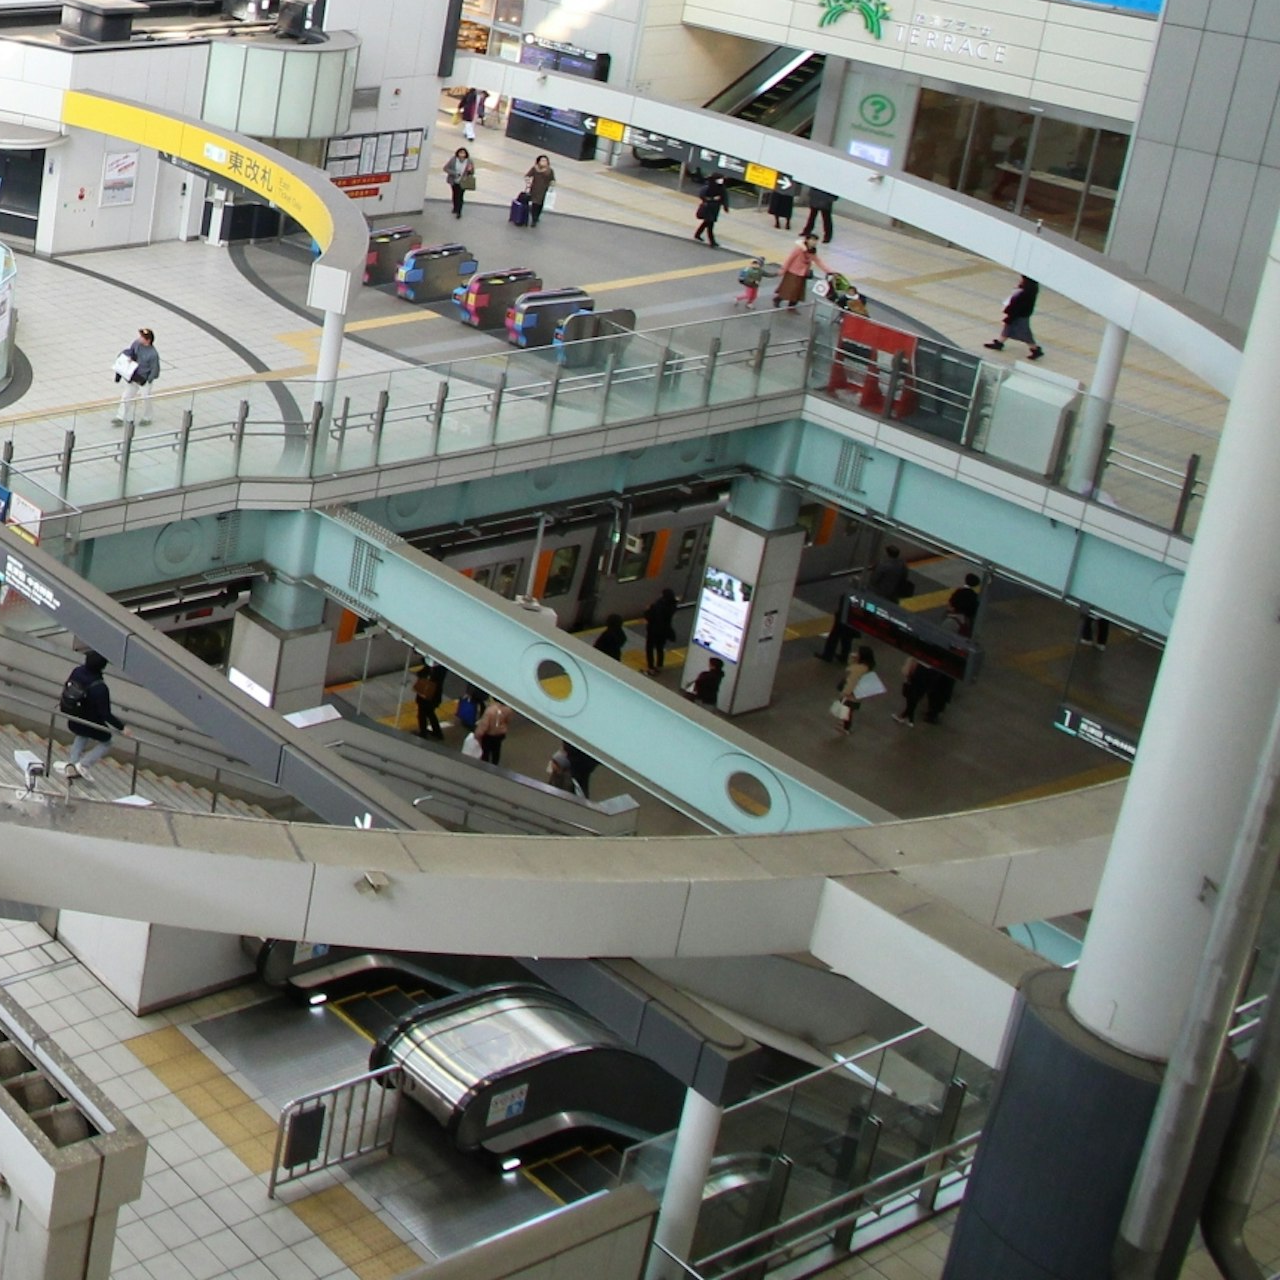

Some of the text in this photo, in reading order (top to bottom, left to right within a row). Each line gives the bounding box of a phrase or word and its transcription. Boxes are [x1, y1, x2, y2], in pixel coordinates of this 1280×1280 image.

[895, 24, 1008, 64] TERRACE
[227, 150, 273, 193] 東改札
[1064, 709, 1072, 727] 1
